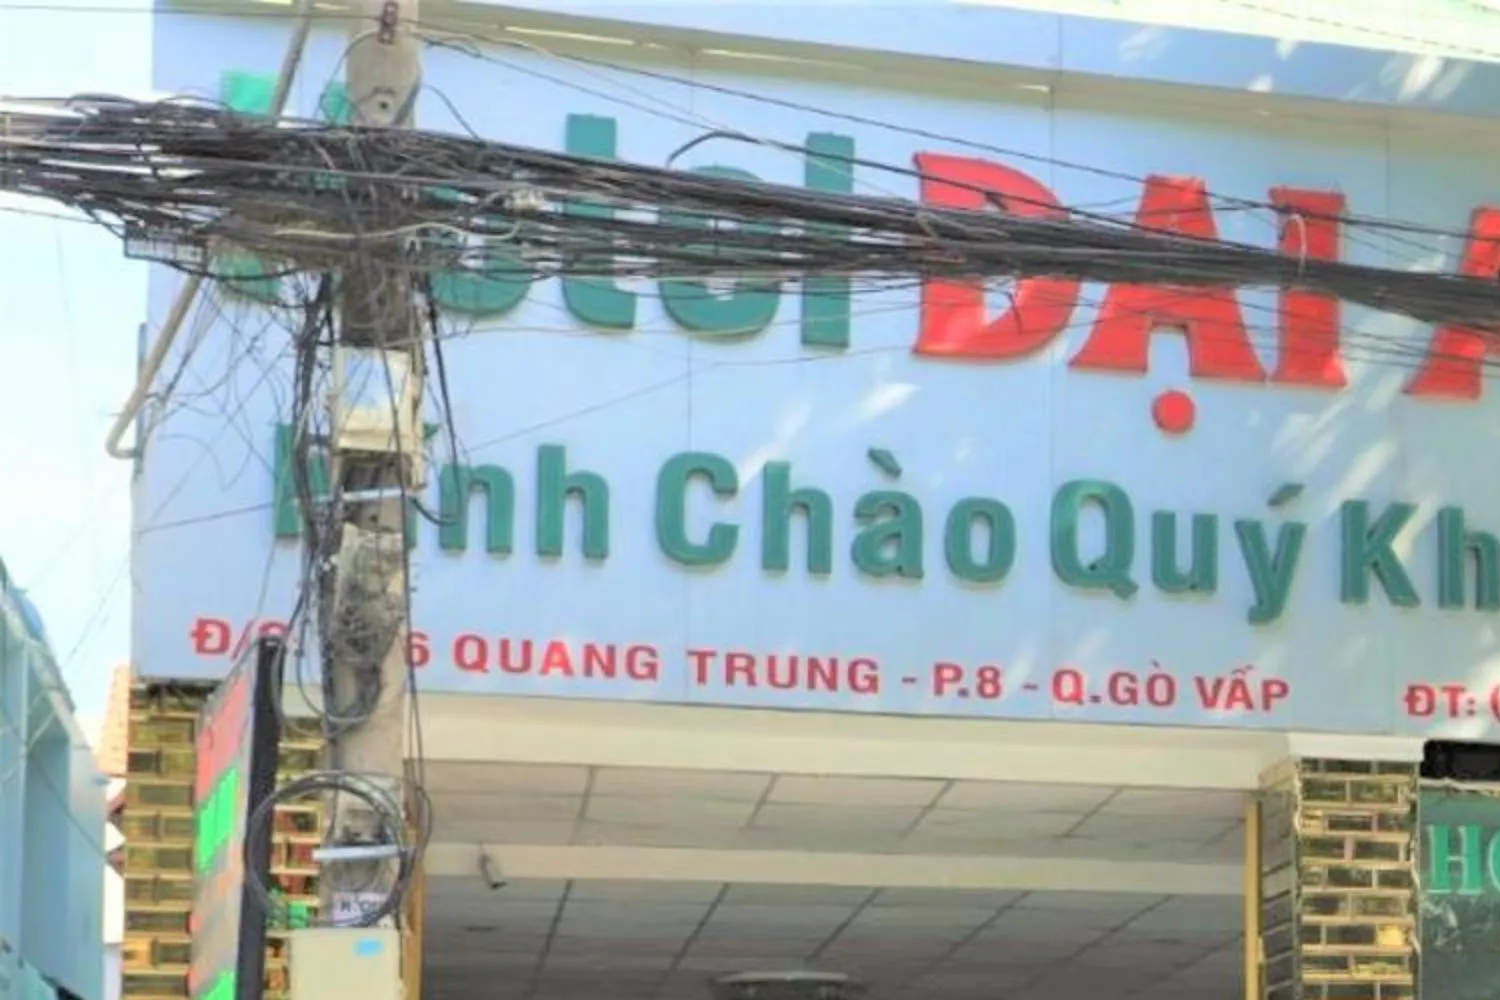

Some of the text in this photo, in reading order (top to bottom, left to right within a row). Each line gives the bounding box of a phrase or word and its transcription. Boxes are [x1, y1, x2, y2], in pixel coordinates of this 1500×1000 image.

[215, 68, 857, 348] otel
[912, 150, 1348, 436] ĐẠI
[272, 422, 610, 564] nh
[655, 447, 1018, 586] Chào
[1049, 476, 1308, 626] Quý
[452, 632, 660, 682] QUANG
[686, 649, 881, 696] TRUNG
[932, 662, 1002, 702] P.8
[1050, 658, 1178, 708] Q.GÒ
[1194, 664, 1292, 714] VẤP
[1402, 684, 1478, 722] ĐT:
